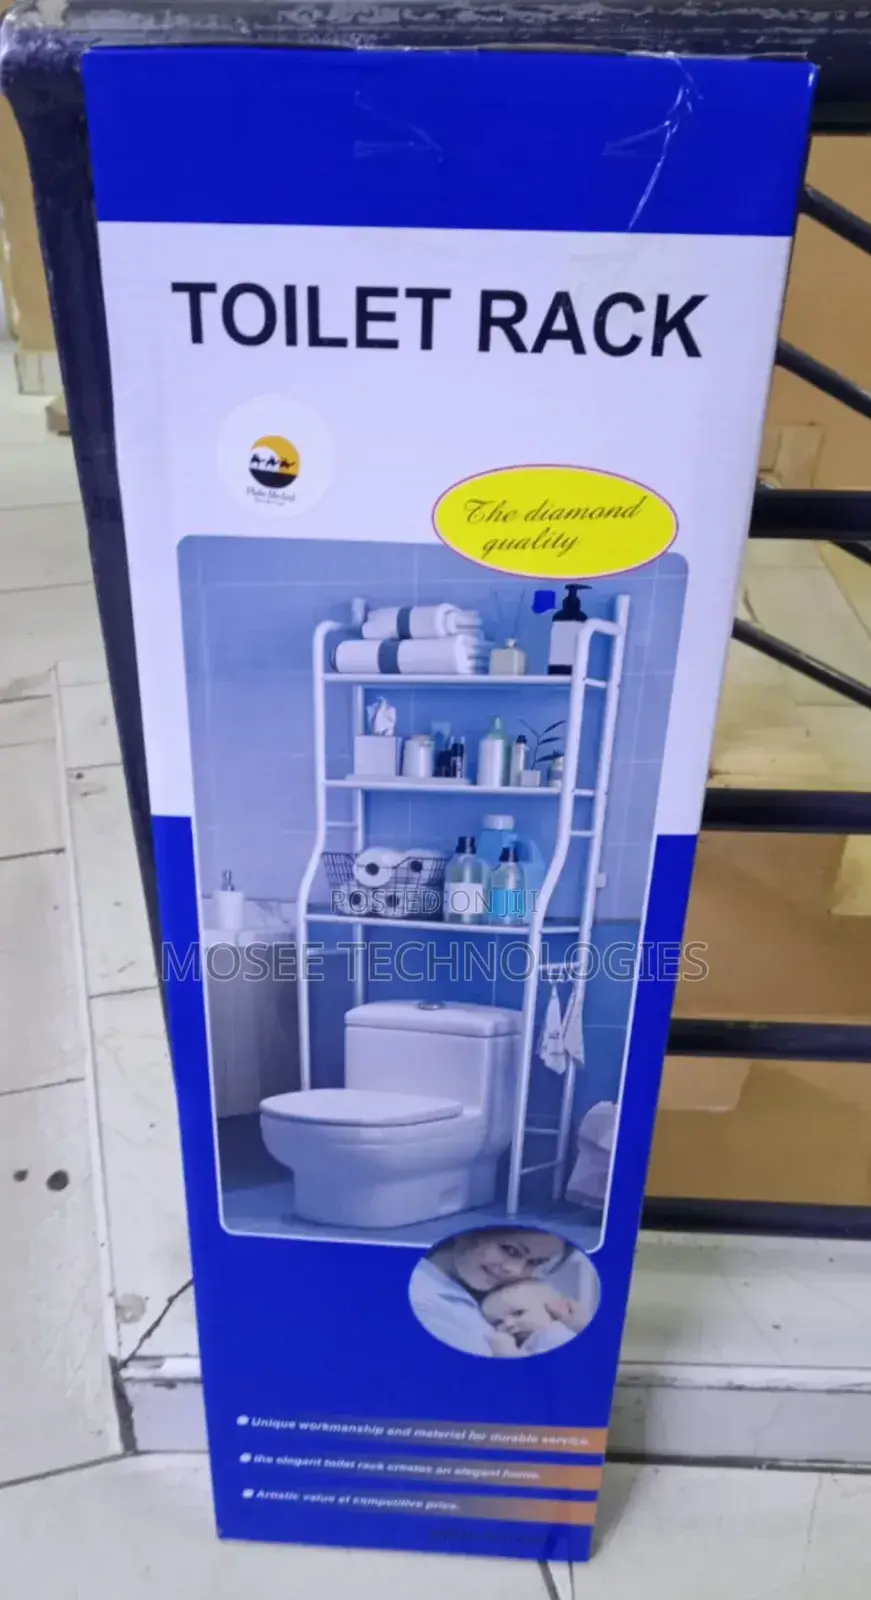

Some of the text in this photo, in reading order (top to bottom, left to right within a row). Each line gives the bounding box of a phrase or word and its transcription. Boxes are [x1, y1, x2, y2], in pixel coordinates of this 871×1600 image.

[171, 281, 708, 358] TOILET RACK
[464, 495, 648, 524] The diamond
[481, 526, 580, 559] quality
[251, 1416, 296, 1430] Unique
[300, 1421, 383, 1436] workmanship
[387, 1426, 412, 1437] and
[414, 1429, 466, 1440] material
[468, 1431, 487, 1441] for
[490, 1433, 539, 1444] durable
[276, 1455, 321, 1468] elegant
[324, 1458, 355, 1469] toilet
[357, 1460, 385, 1471] rack
[435, 1465, 451, 1475] an
[454, 1467, 501, 1479] elegant
[303, 1494, 335, 1503] value
